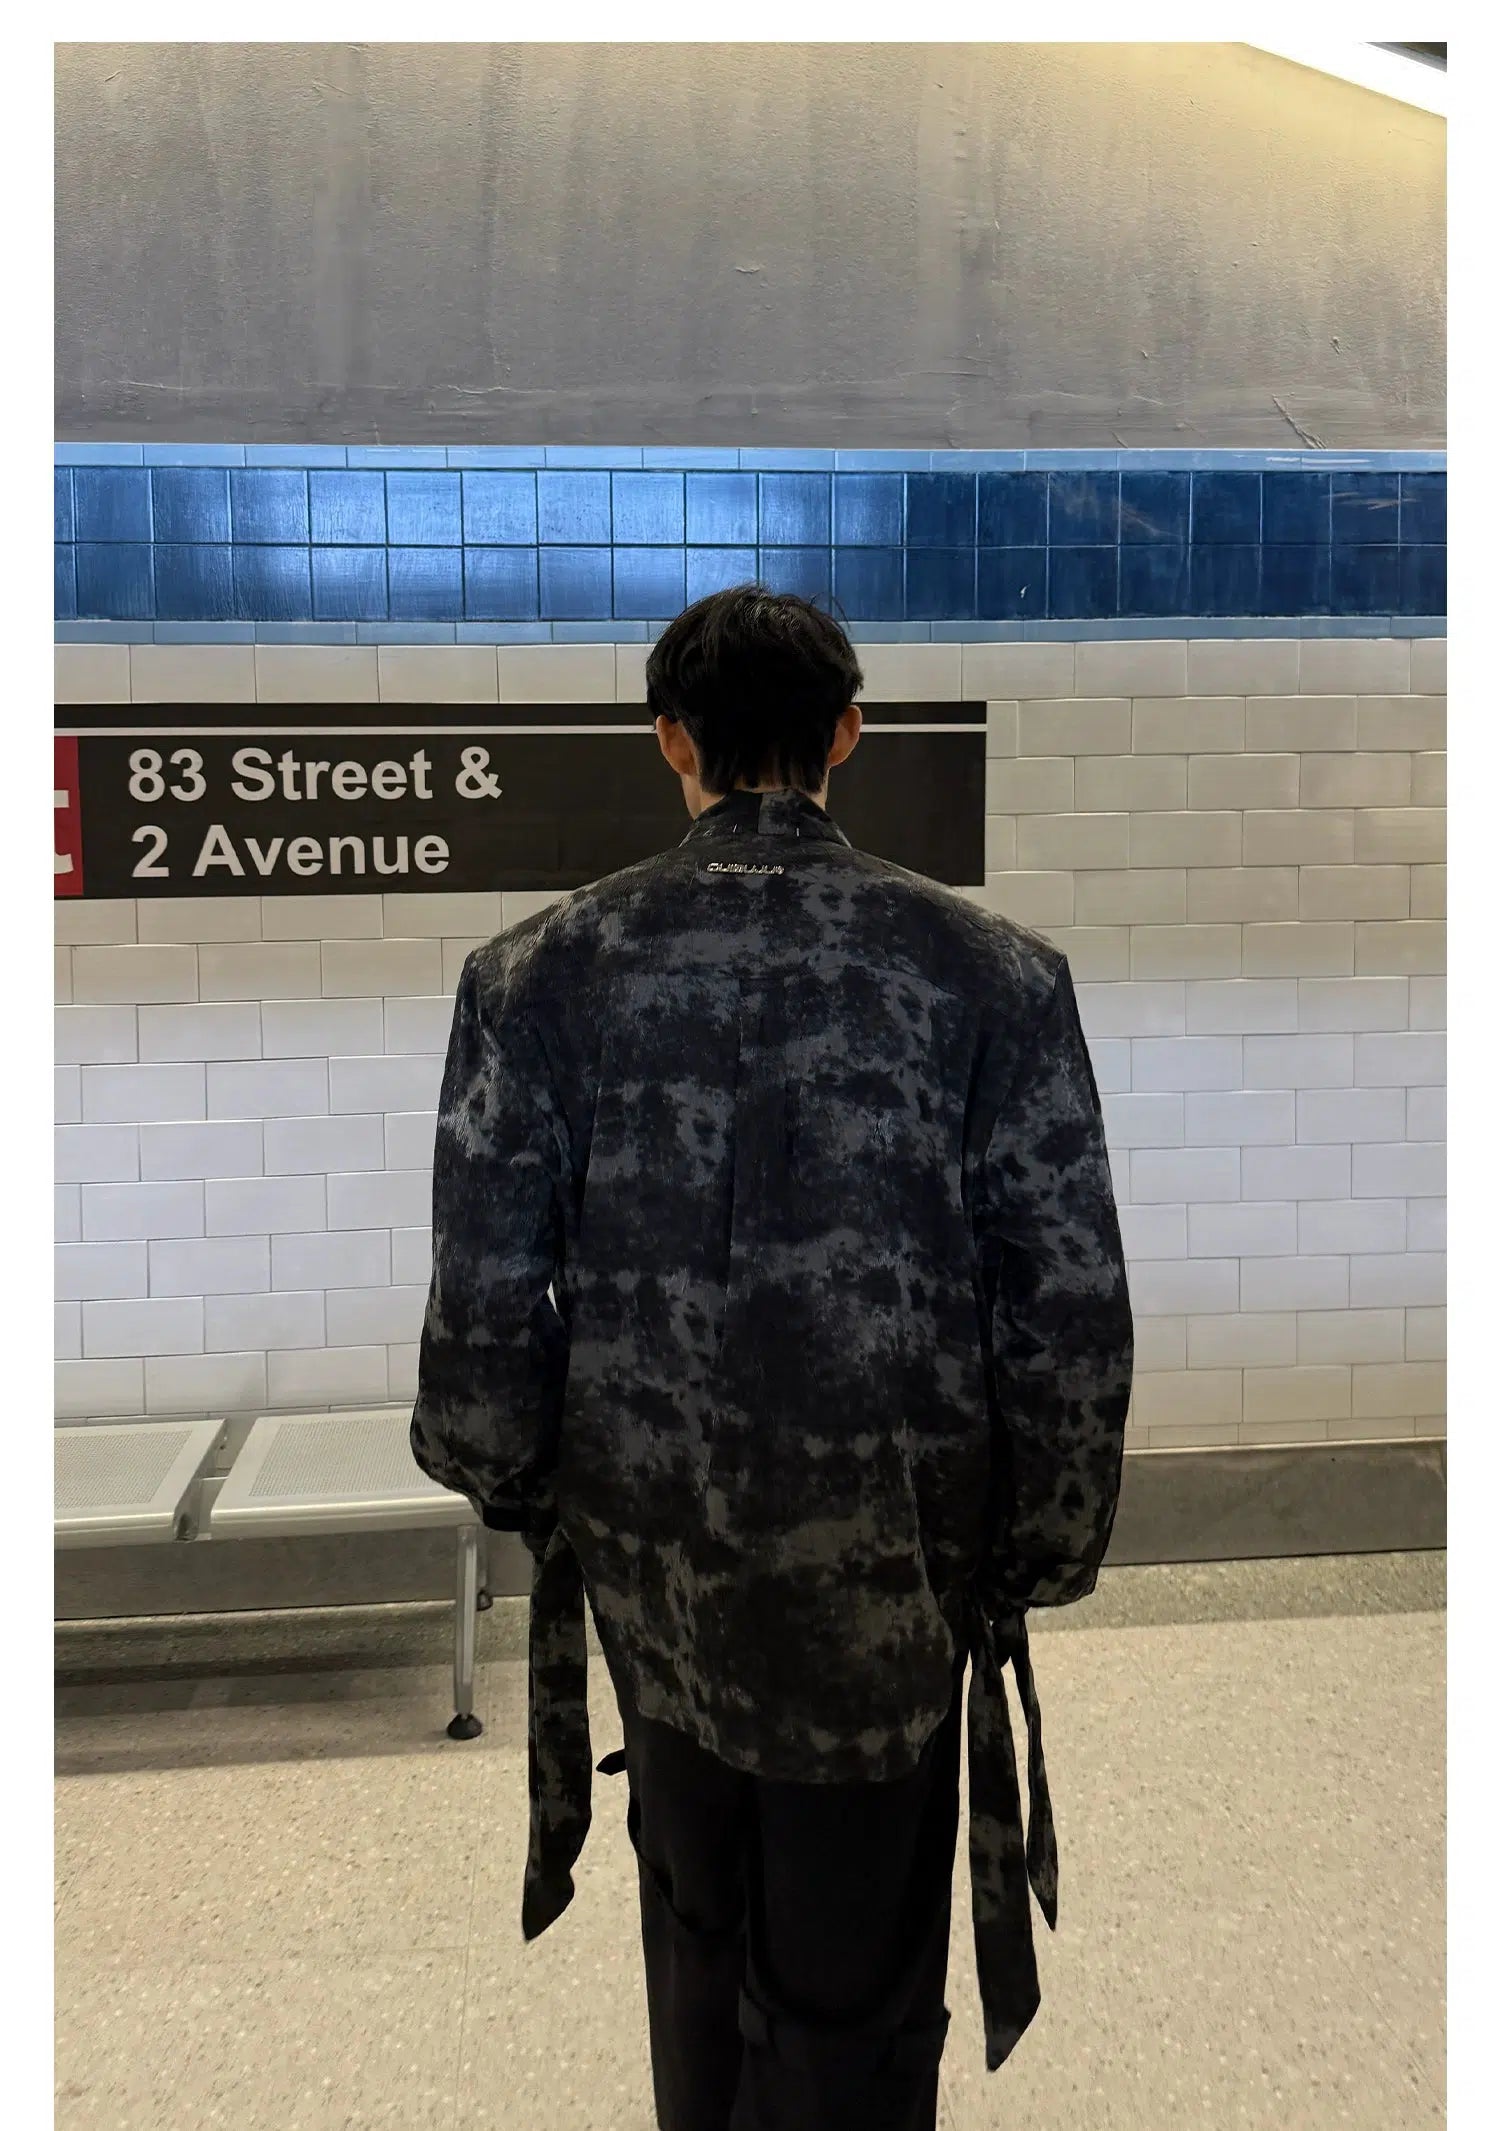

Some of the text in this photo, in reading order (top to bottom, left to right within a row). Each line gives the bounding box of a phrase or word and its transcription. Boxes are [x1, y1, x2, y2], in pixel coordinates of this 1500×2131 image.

[129, 746, 503, 802] 83 Street &
[131, 826, 169, 877] 2
[192, 825, 449, 877] Avenue
